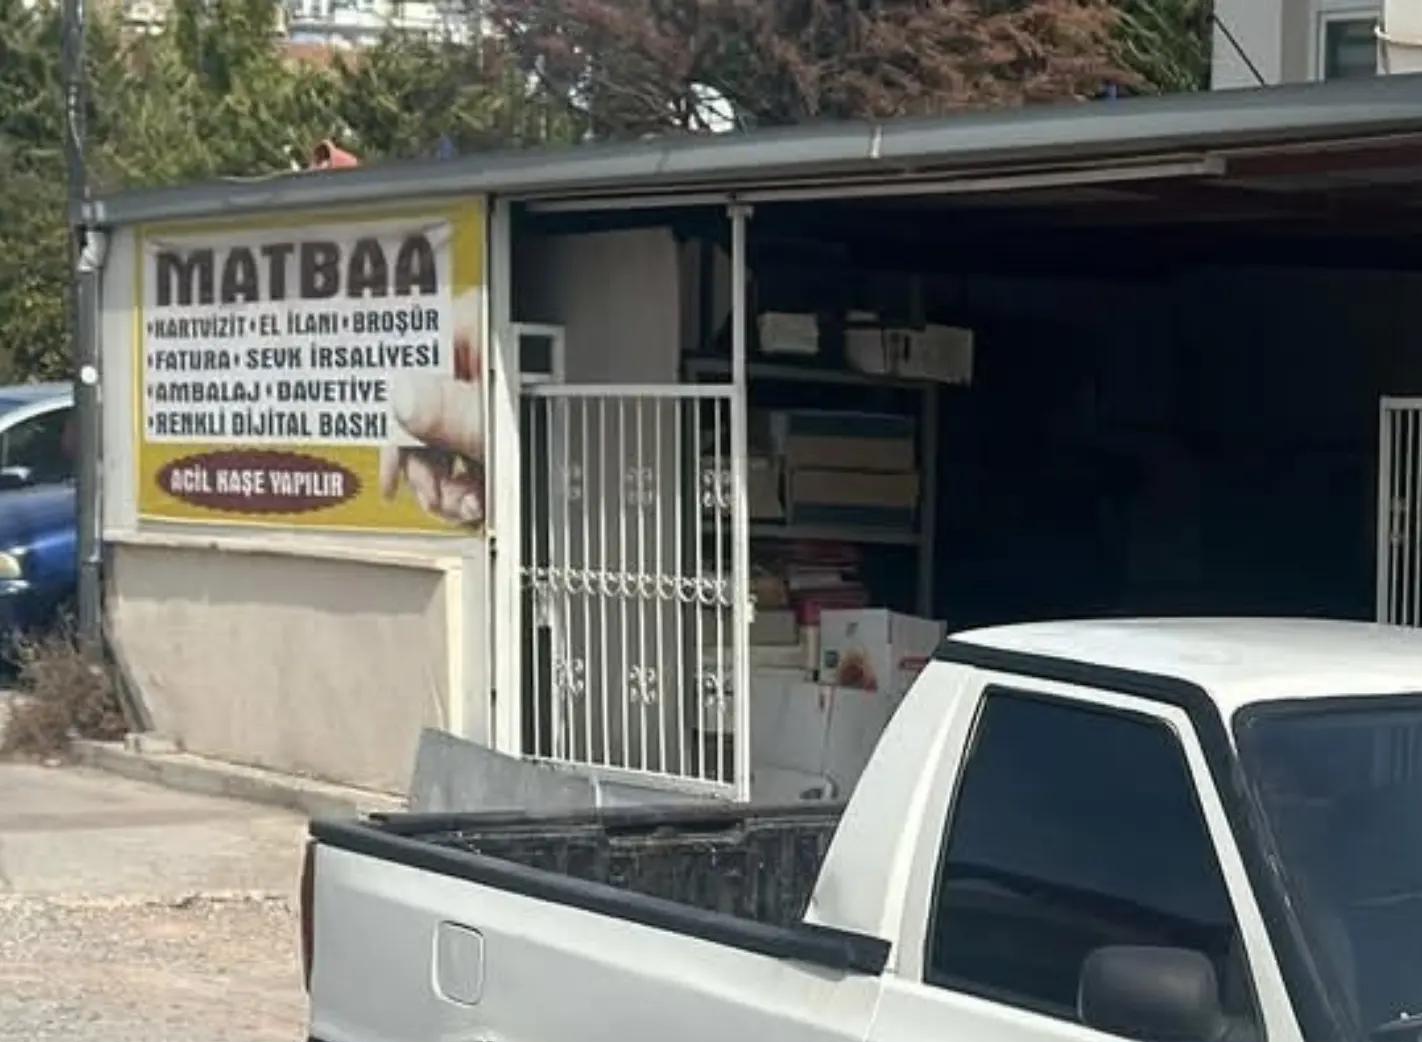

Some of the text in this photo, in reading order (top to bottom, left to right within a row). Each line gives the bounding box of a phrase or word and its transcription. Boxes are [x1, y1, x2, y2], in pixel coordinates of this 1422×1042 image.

[156, 233, 438, 307] MATBAA
[154, 305, 439, 339] KARTVİZİT EL İLANI BROŞÜR
[155, 340, 439, 371] FATURA SEVK İRSALİYESİ
[154, 375, 388, 403] AMBALAJ DAVETİYE
[154, 407, 388, 438] RENKLİ DİJİTAL BASKI
[170, 464, 345, 498] ACİL KAŞE YAPILIR
